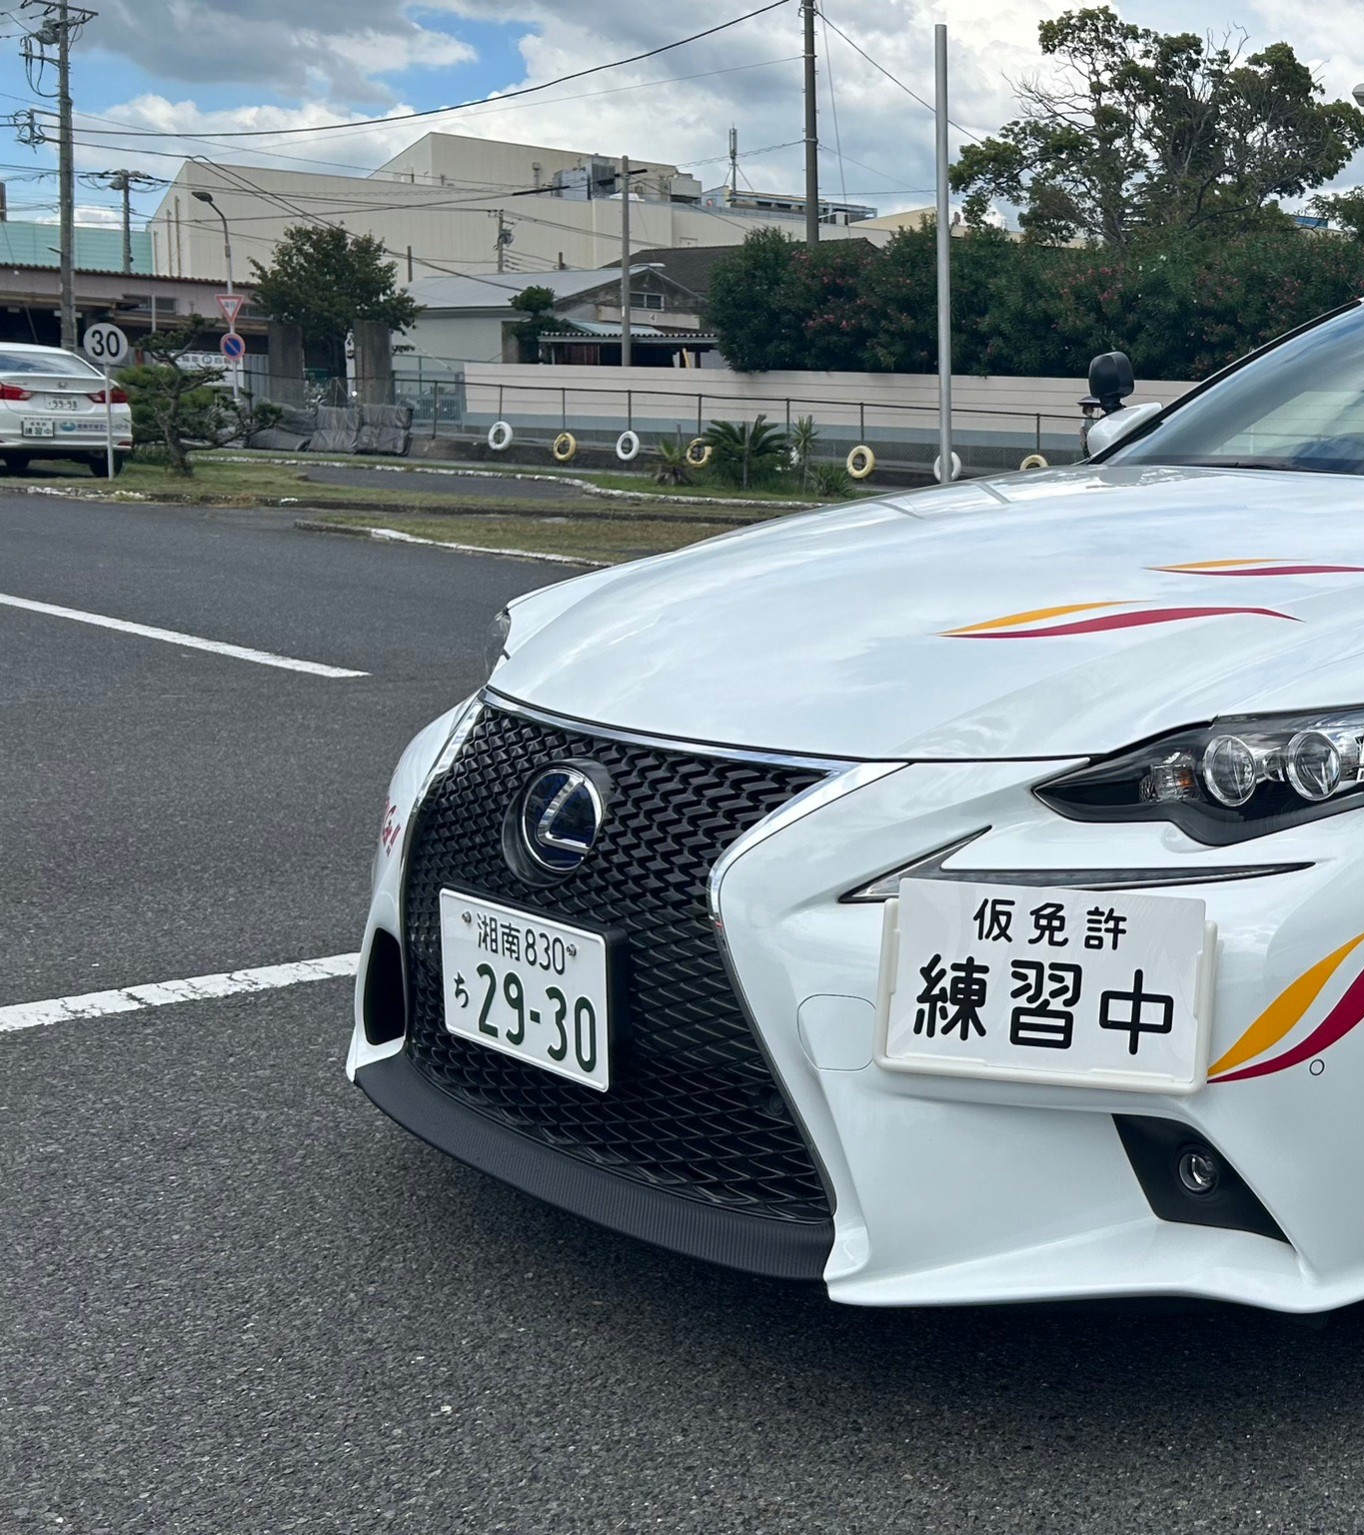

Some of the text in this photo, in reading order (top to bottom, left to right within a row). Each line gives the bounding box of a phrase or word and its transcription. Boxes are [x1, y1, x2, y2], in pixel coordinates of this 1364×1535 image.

[91, 330, 120, 357] 30
[477, 912, 566, 976] 湘南830
[973, 898, 1127, 950] 仮免許
[453, 962, 597, 1073] ち 29-30
[913, 954, 1174, 1056] 練習中
